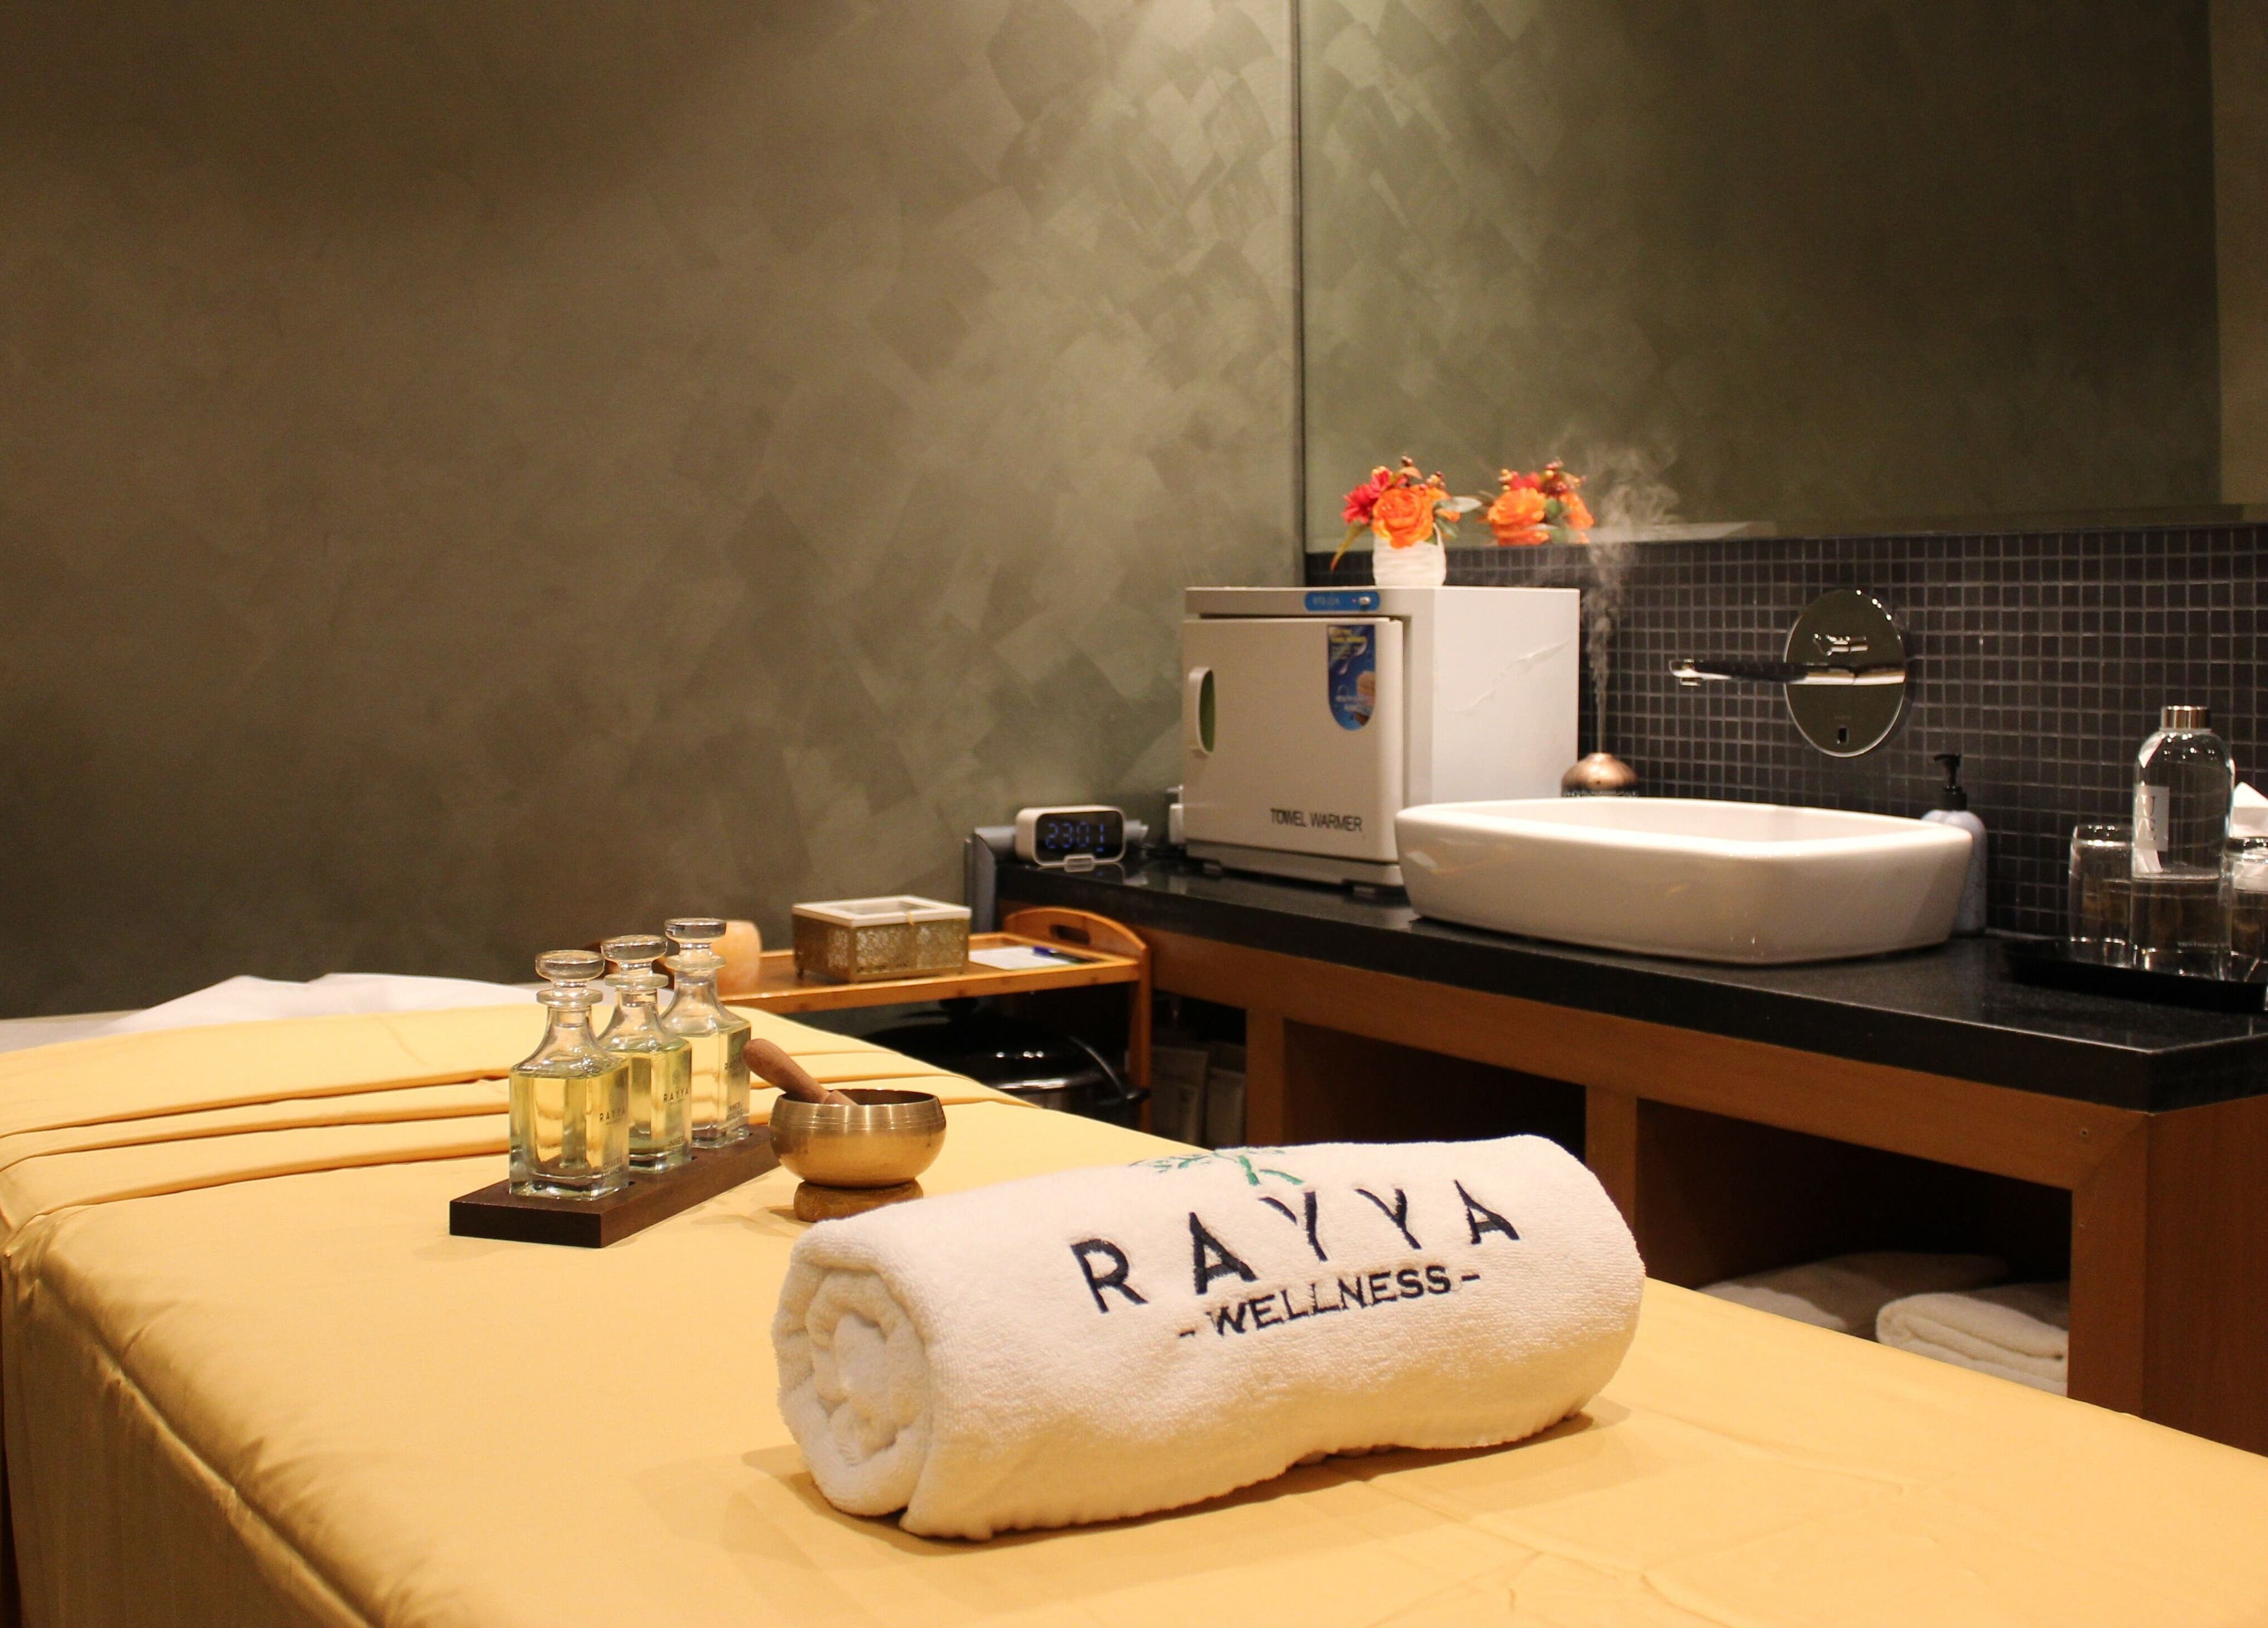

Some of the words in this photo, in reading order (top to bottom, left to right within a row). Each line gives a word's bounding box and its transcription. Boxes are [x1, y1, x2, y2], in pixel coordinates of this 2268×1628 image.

[1270, 808, 1306, 828] TOWEL
[1309, 812, 1363, 832] WARMER
[663, 1087, 689, 1103] RAYYA
[599, 1106, 625, 1122] RAYYA
[1070, 1179, 1520, 1313] RAYYA
